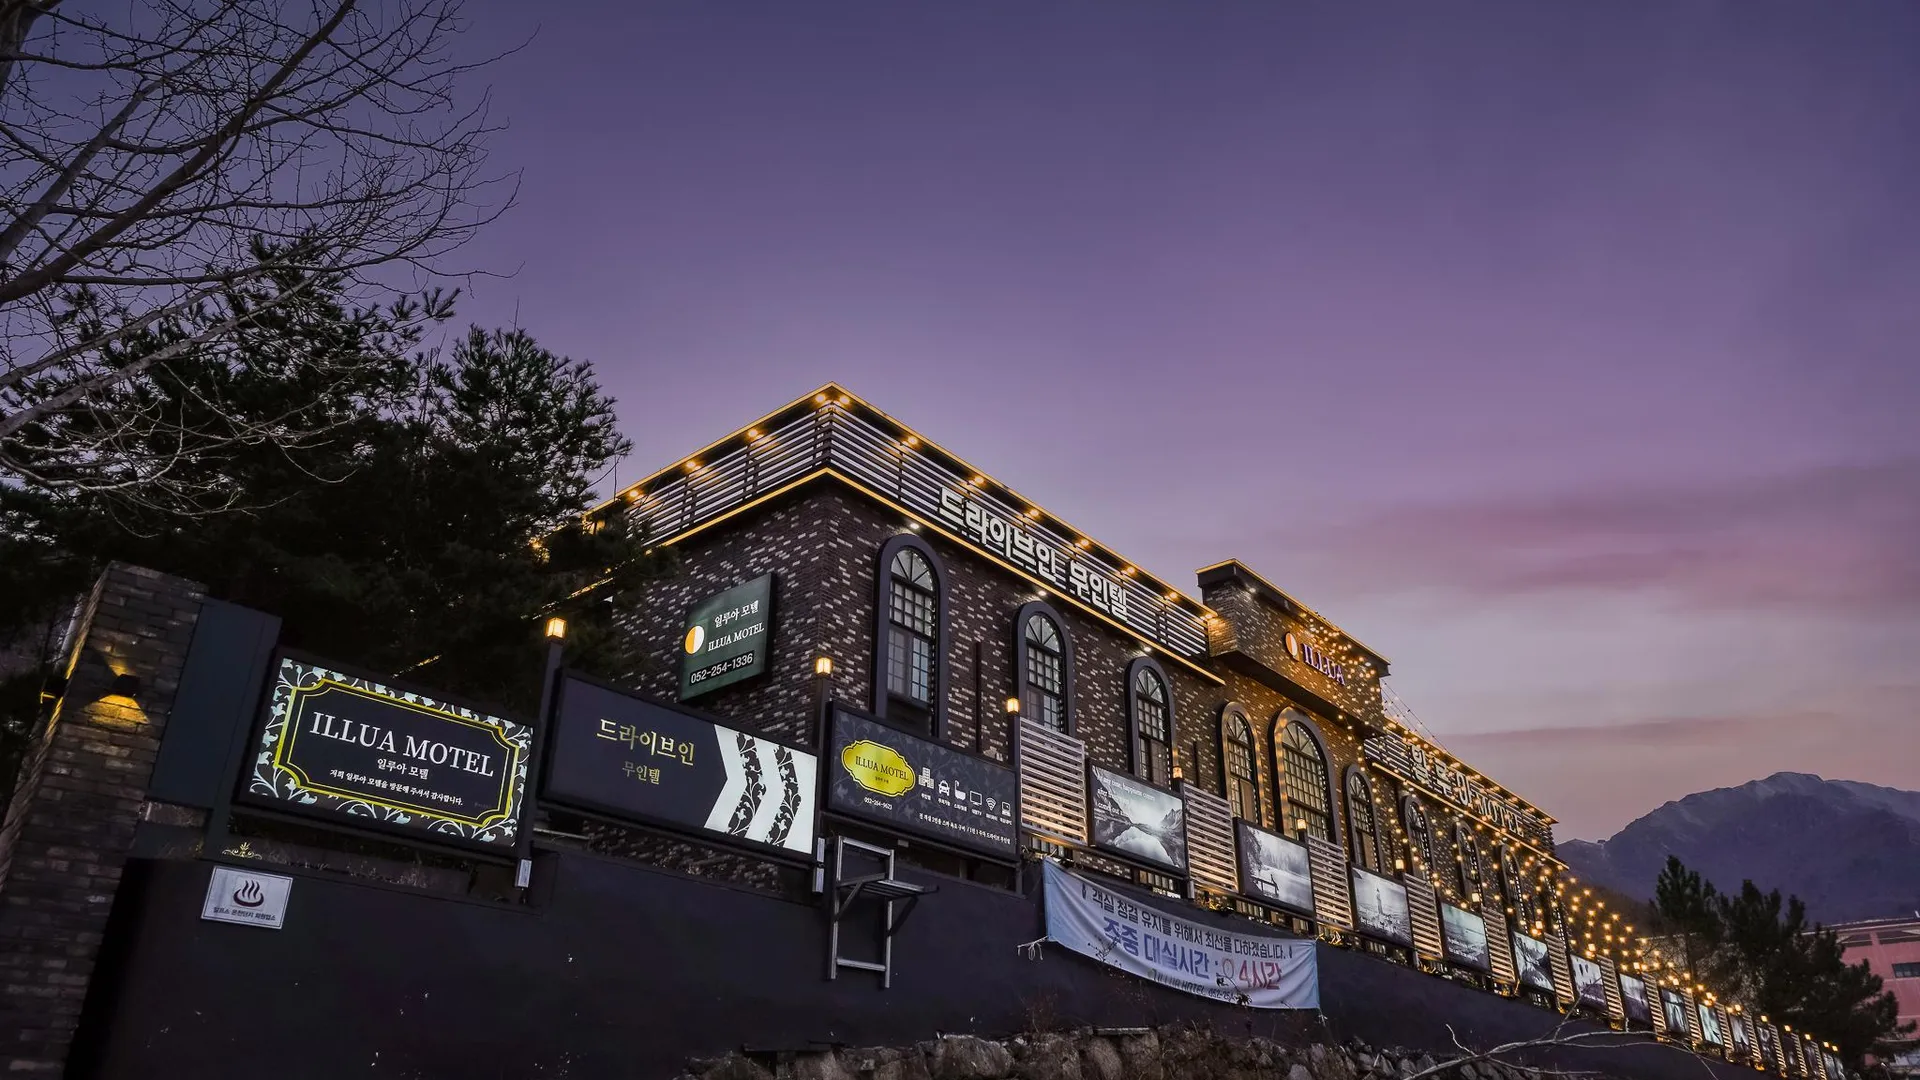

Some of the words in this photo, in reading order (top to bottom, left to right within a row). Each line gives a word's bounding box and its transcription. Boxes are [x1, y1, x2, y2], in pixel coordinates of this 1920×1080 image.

[939, 487, 1057, 583] 드라이브인
[1069, 560, 1128, 621] 무인텔
[714, 608, 739, 628] 일루아
[740, 600, 759, 616] 모텔
[708, 635, 732, 652] ILLUA
[733, 622, 764, 642] MOTEL
[691, 653, 753, 683] 052-254-1336
[1302, 643, 1345, 686] ILLUA
[309, 711, 397, 754] ILLUA
[403, 735, 494, 777] MOTEL
[596, 718, 695, 766] 드라이브인
[330, 769, 345, 779] 저희
[377, 758, 407, 775] 일루아
[408, 766, 429, 780] 모텔
[622, 761, 660, 785] 무인텔
[855, 755, 878, 772] ILLUA
[880, 764, 909, 781] MOTEL
[1092, 889, 1114, 914] 객실
[1117, 900, 1139, 924] 청결
[1141, 911, 1172, 936] 유지를
[1174, 922, 1203, 945] 위해서
[1205, 931, 1232, 953] 최선을
[1234, 939, 1286, 959] 다하겠습니다.
[1144, 934, 1210, 979] 대실시간
[1238, 960, 1282, 990] 4시간
